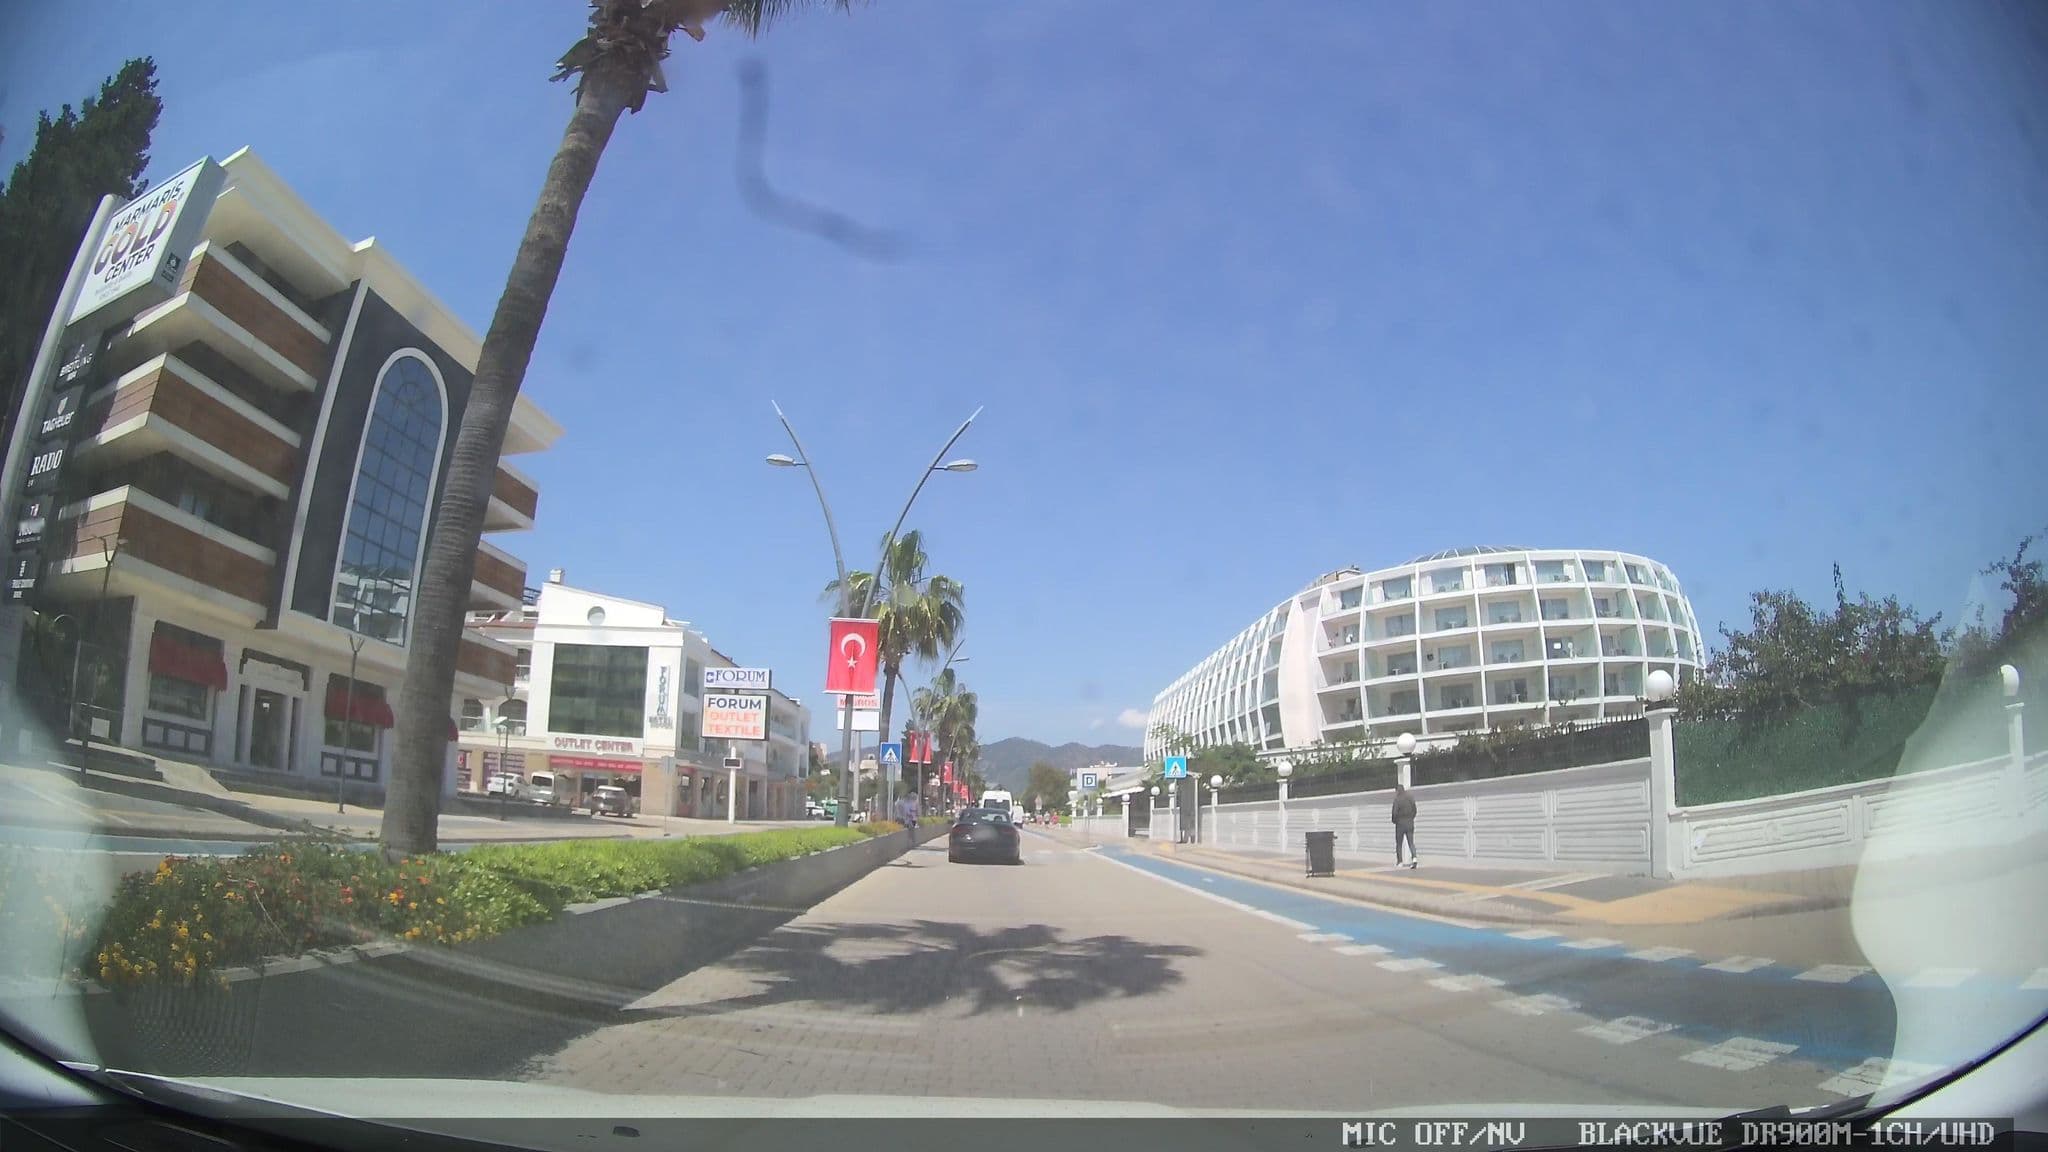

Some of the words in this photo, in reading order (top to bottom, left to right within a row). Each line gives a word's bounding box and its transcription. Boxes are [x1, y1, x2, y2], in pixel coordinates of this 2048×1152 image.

[94, 199, 178, 275] GOLD
[104, 243, 155, 283] CENTER
[30, 449, 63, 476] RADO
[716, 670, 766, 682] FORUM
[708, 697, 762, 710] FORUM
[711, 711, 758, 722] OUTLET
[708, 724, 761, 736] TEXTILE
[554, 737, 593, 749] OUTLET
[594, 740, 634, 752] CENTER
